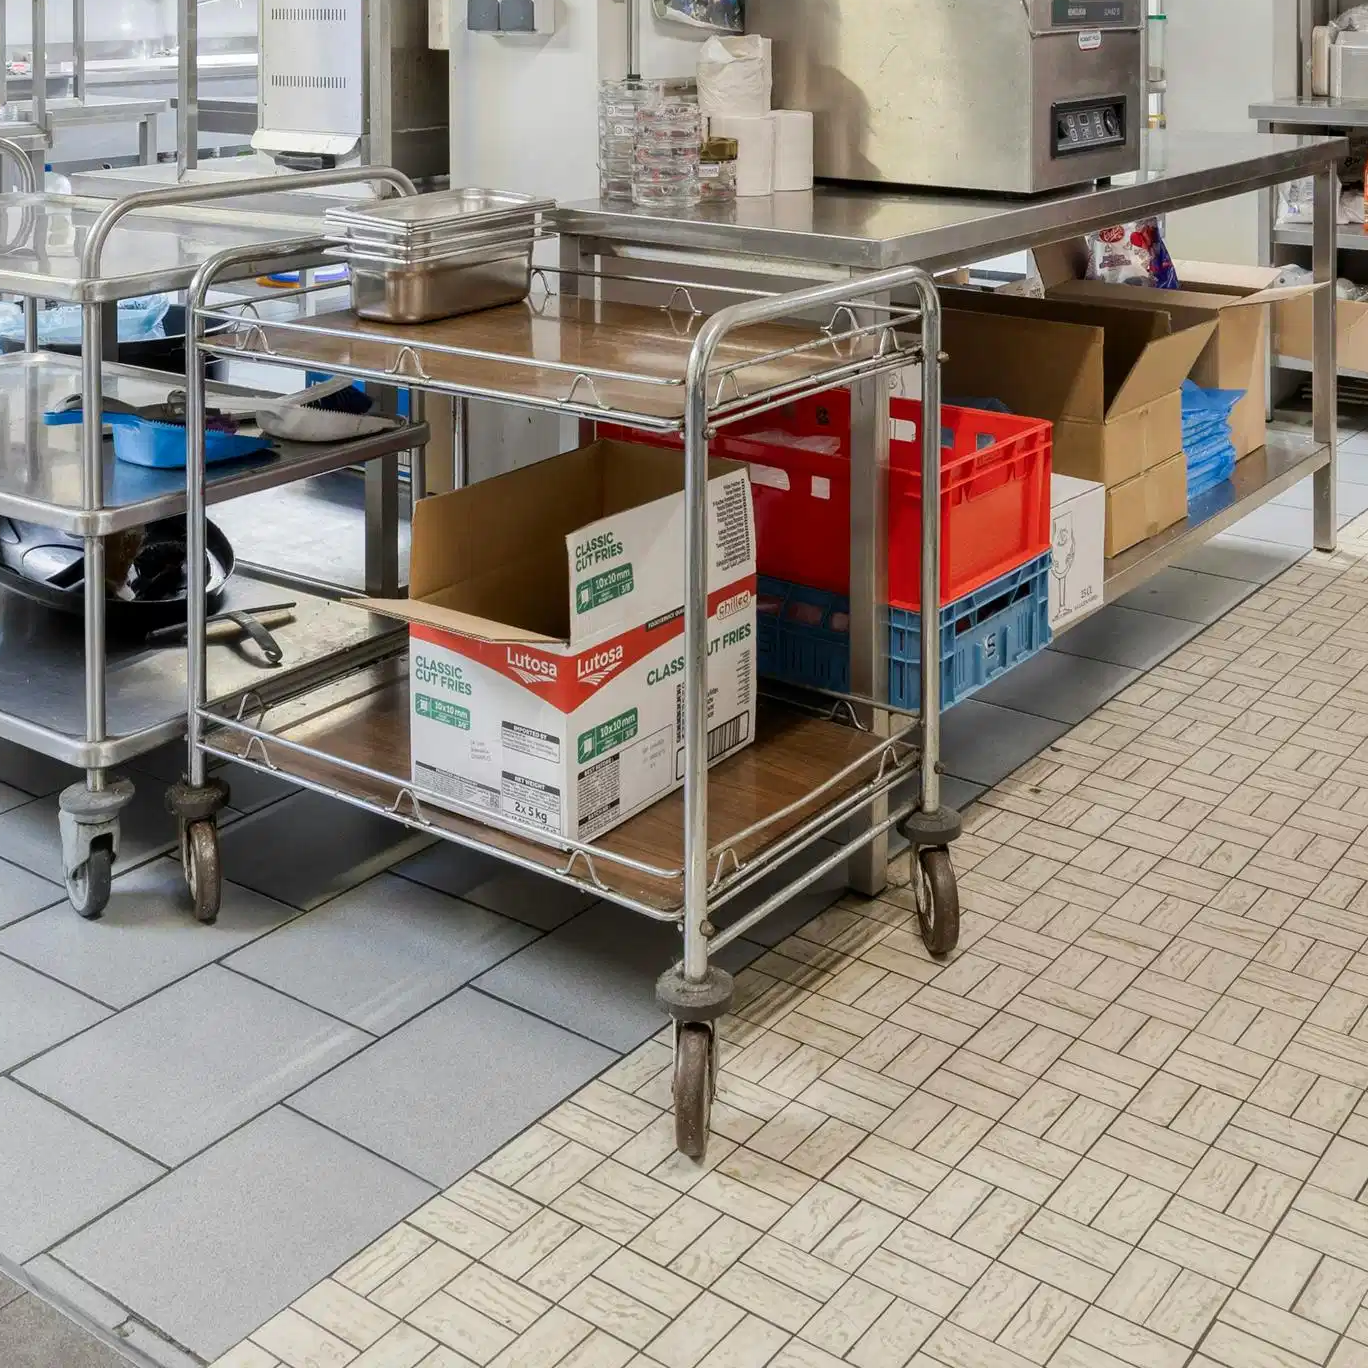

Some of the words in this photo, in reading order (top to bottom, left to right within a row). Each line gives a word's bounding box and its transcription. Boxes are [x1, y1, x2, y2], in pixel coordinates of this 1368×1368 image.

[575, 531, 614, 559] CLASSIC
[575, 555, 595, 573] CUT
[595, 542, 624, 564] FRIES
[595, 572, 616, 593] 10x10
[718, 593, 749, 617] chilled
[506, 646, 558, 677] Lutosa
[577, 644, 624, 677] Lutosa
[646, 655, 685, 686] CLASS
[707, 638, 721, 657] UT
[723, 622, 752, 649] FRIES
[415, 655, 464, 679] CLASSIC
[415, 667, 437, 686] CUT
[441, 676, 472, 696] FRIES
[435, 700, 454, 716] 10x10
[514, 725, 540, 738] IMPORTED
[600, 718, 622, 738] 10x10
[515, 776, 525, 785] NET
[525, 780, 545, 790] WEIGHT
